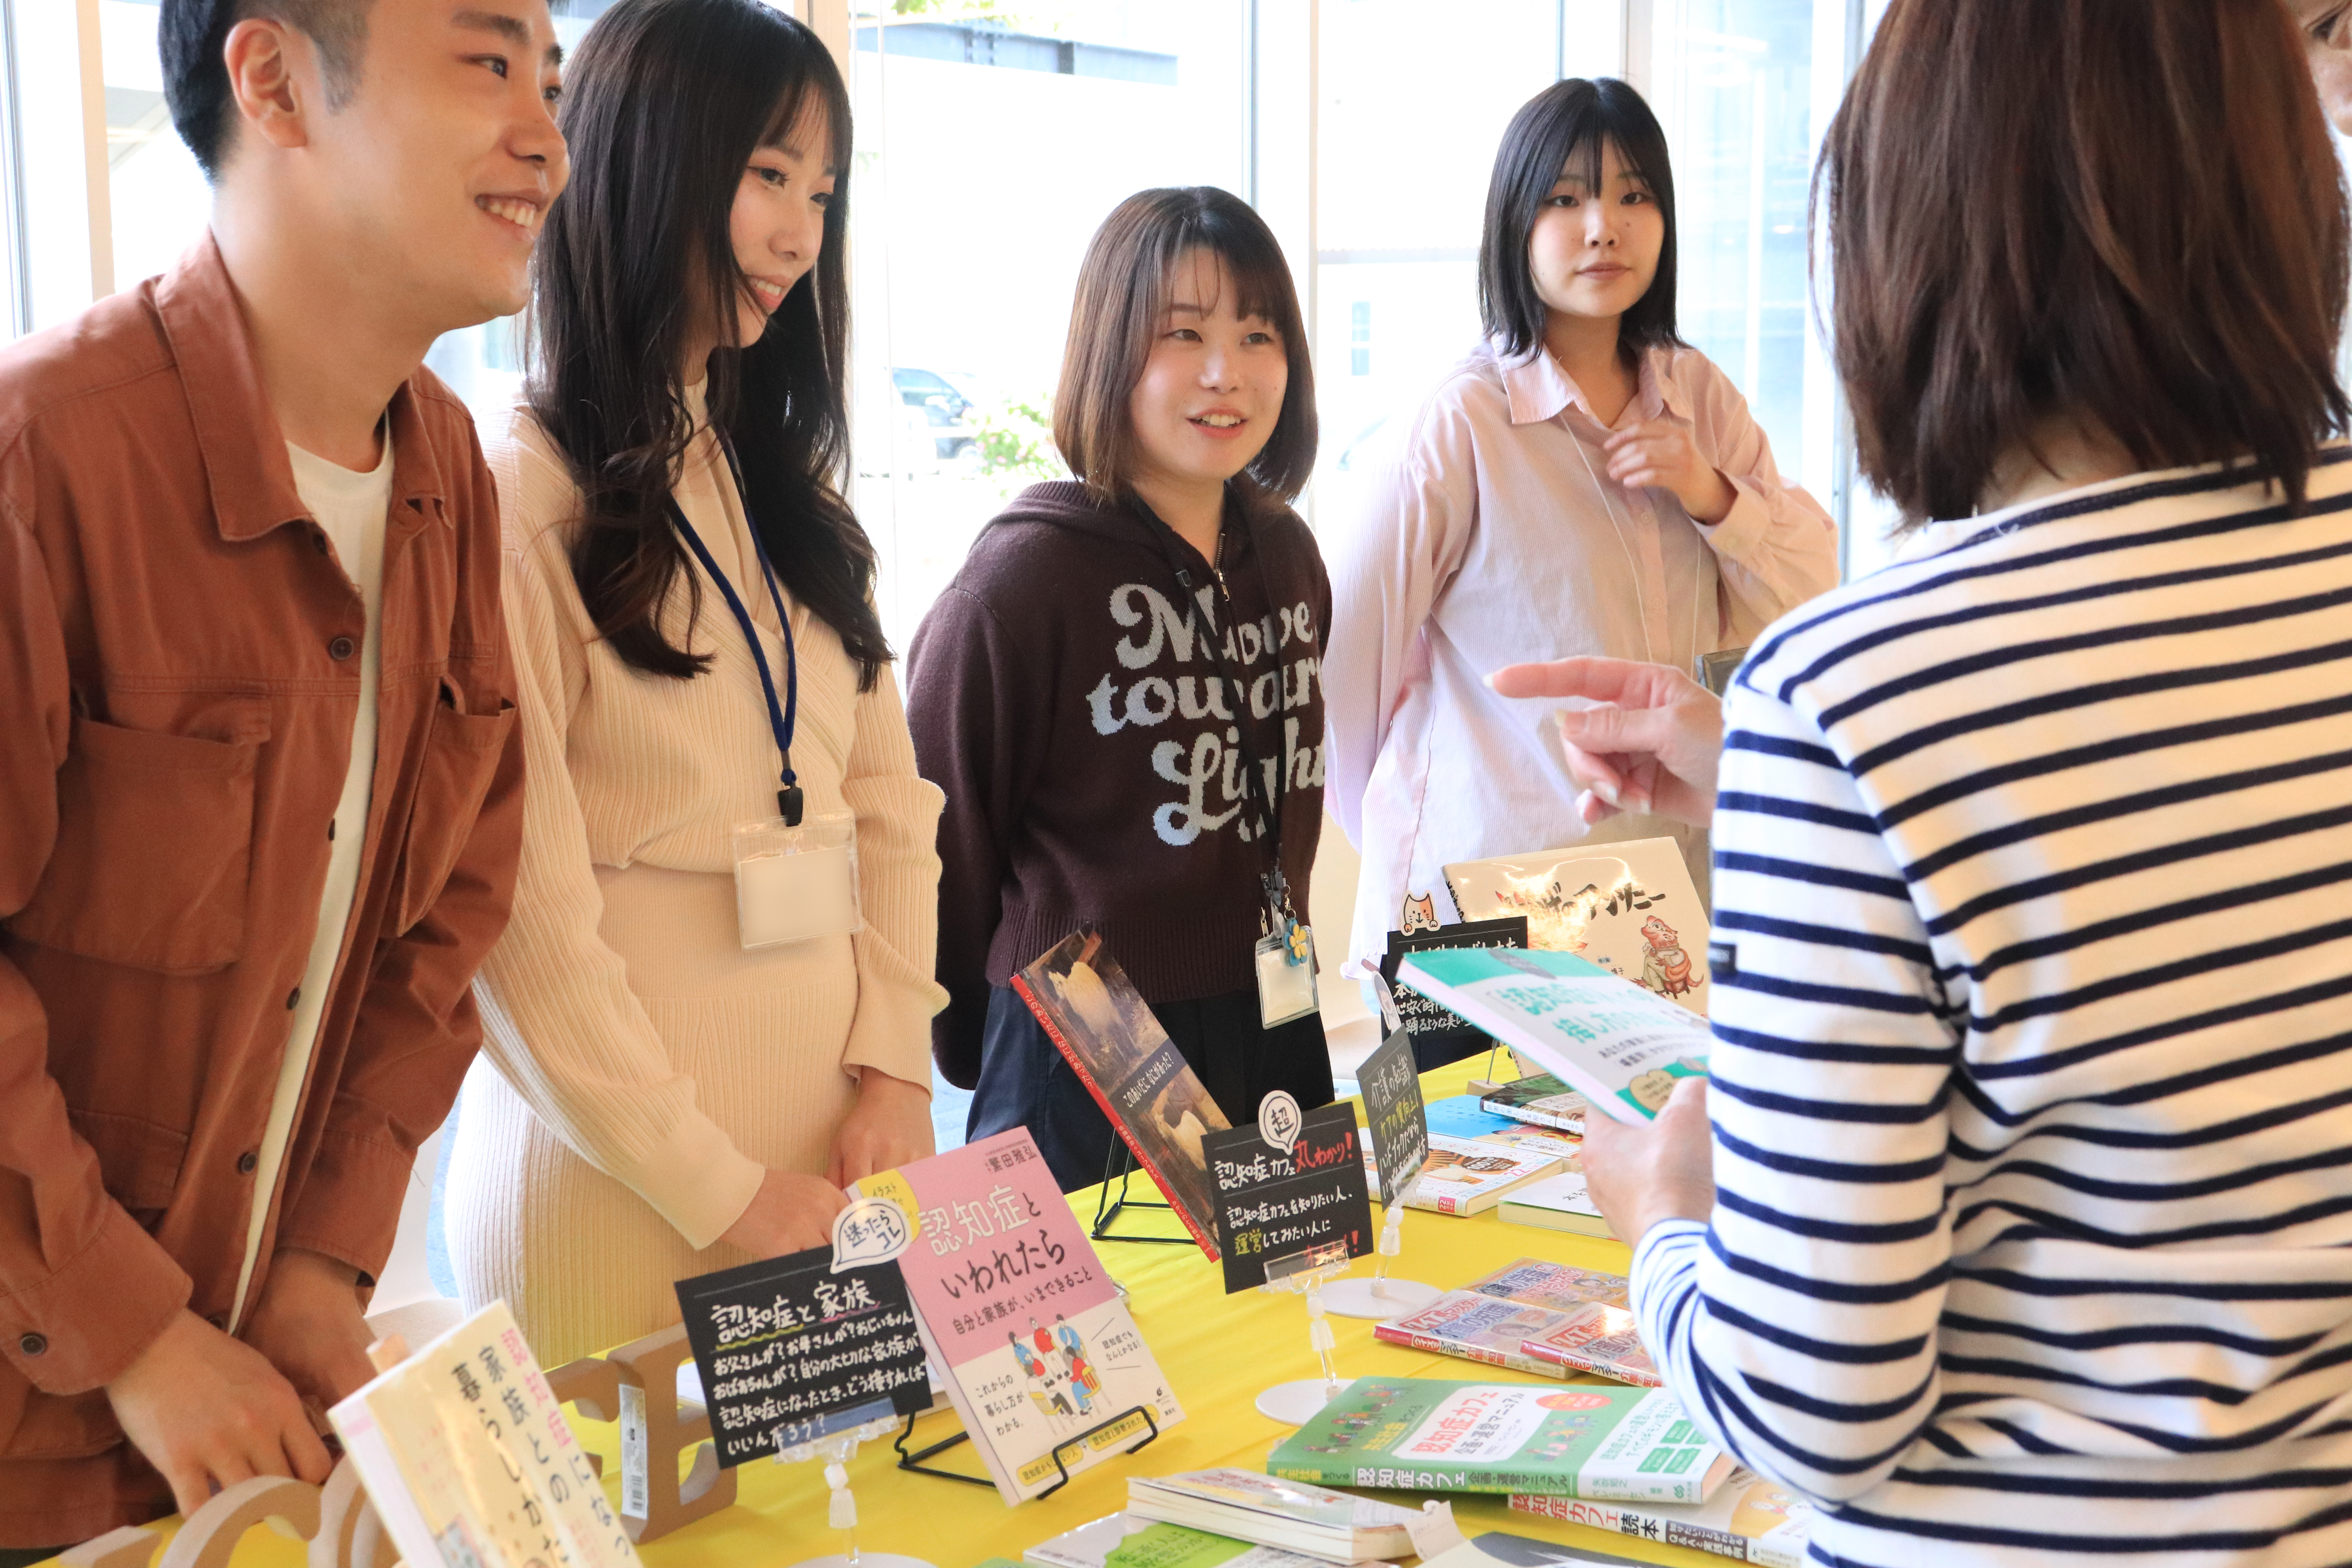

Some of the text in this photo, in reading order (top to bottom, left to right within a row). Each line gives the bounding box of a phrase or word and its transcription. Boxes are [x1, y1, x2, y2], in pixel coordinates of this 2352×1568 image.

[1109, 583, 1314, 670] Move
[1085, 656, 1325, 736] towar
[1025, 995, 1058, 1039] このあいだに
[1372, 1053, 1411, 1112] 介護の知識
[1272, 1107, 1294, 1137] 超
[844, 1210, 890, 1248] 迷ったら
[877, 1226, 900, 1250] コレ
[918, 1183, 1042, 1258] 認知症と
[1235, 1220, 1331, 1256] 運営してみたい人に
[941, 1229, 1065, 1299] いわれたら
[710, 1279, 877, 1344] 認知症と家族
[953, 1266, 1093, 1335] 自分と家族が、いまできること
[975, 1375, 1013, 1398] これからの
[1410, 1392, 1499, 1453] 認知症カフェ
[1357, 1467, 1466, 1489] 認知症カフェ
